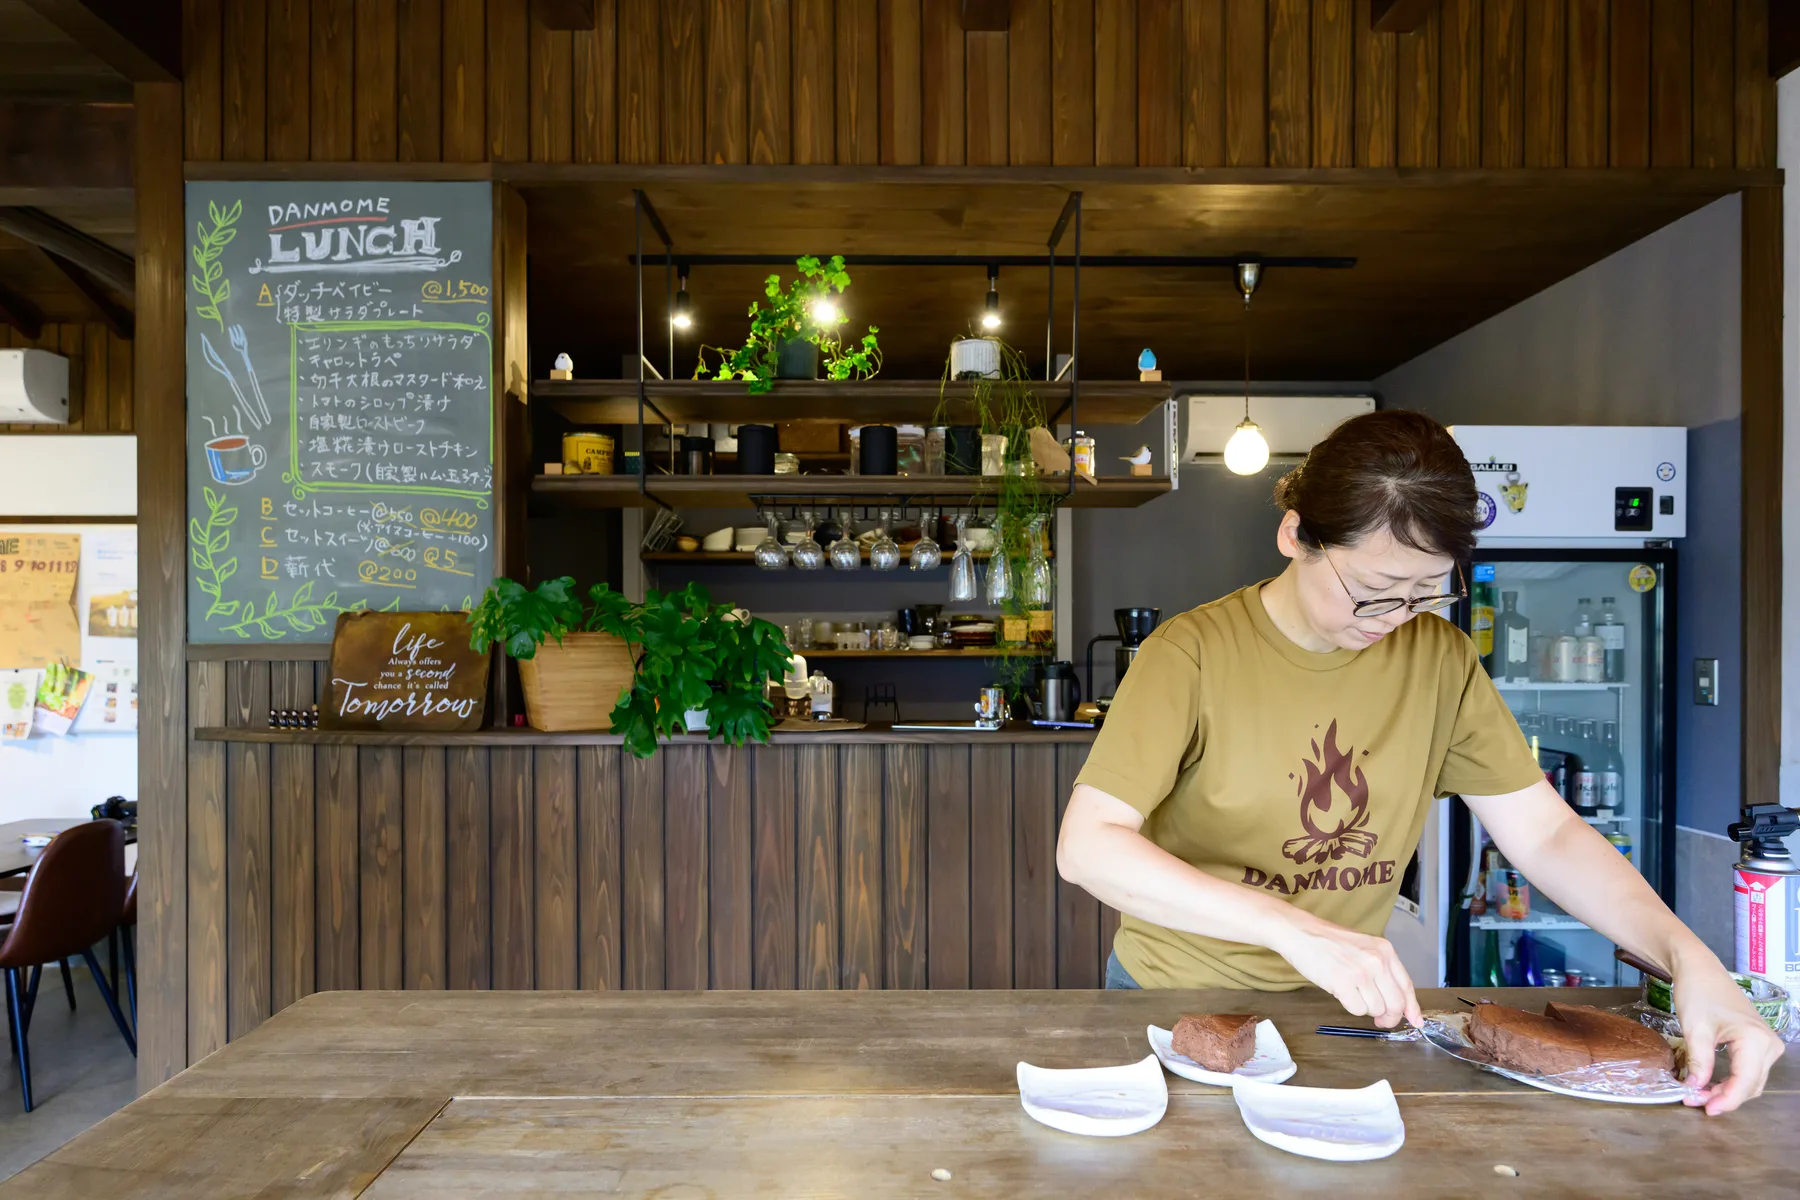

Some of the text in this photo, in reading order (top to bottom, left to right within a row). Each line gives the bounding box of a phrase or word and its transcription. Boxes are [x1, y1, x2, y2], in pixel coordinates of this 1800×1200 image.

[268, 197, 390, 226] DANMOME
[268, 216, 442, 263] LUNCH
[258, 283, 273, 302] A
[421, 280, 488, 298] @1,500
[261, 497, 273, 516] B
[420, 507, 478, 529] @400
[260, 525, 276, 544] C
[262, 556, 278, 577] D
[358, 560, 417, 581] @200
[392, 622, 444, 661] life
[380, 671, 395, 679] you
[405, 663, 456, 680] second
[388, 657, 442, 667] Always offers
[373, 681, 402, 690] chance
[425, 681, 449, 690] called
[331, 678, 478, 721] Tomorrow
[1241, 860, 1396, 895] DANMOME
